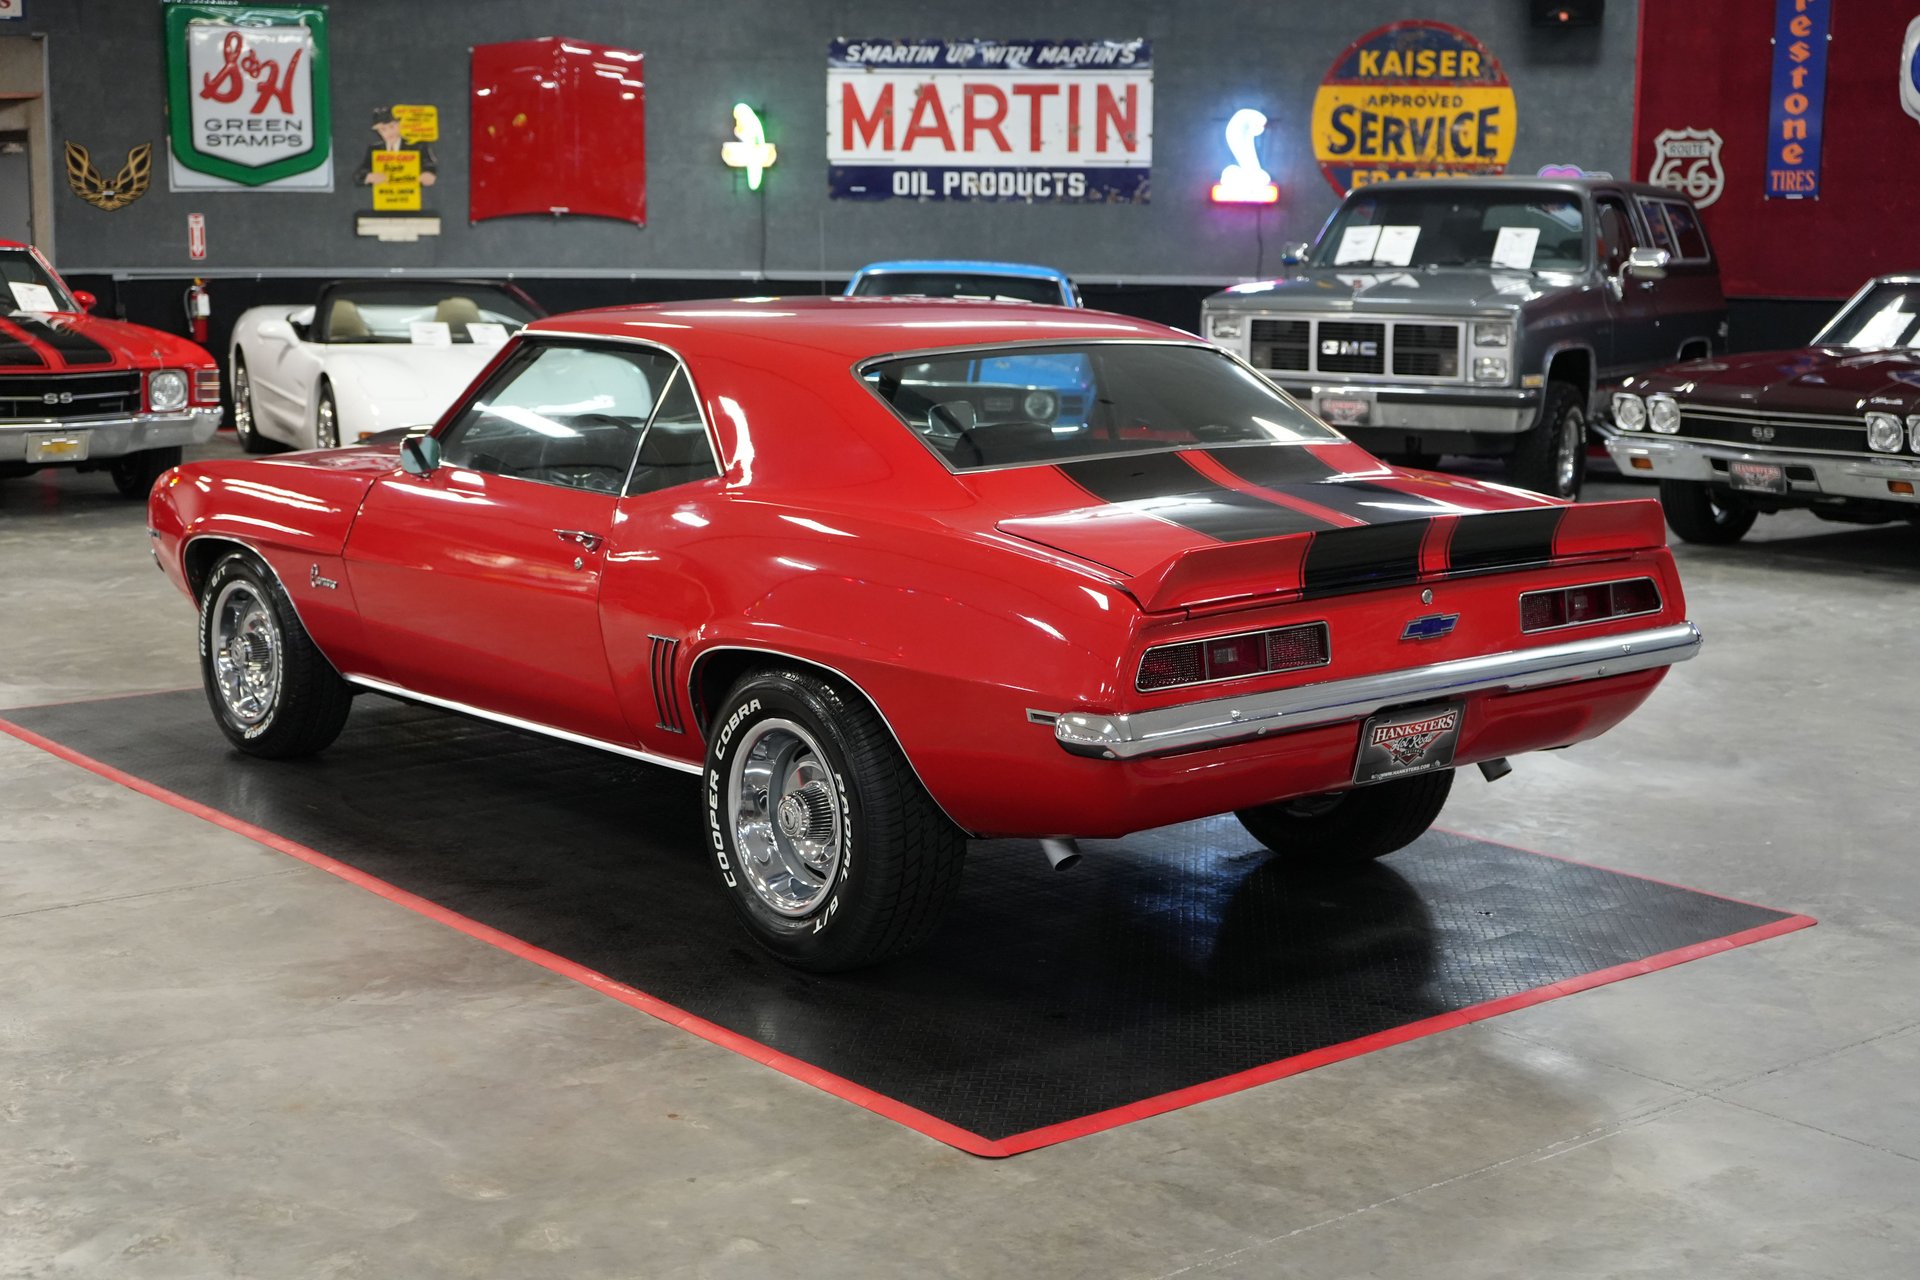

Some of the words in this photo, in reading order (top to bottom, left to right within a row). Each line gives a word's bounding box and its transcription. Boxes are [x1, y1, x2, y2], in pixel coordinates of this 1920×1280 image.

[946, 46, 974, 64] UP
[982, 46, 1031, 63] WITH
[1358, 50, 1481, 77] KAISER
[1366, 95, 1464, 108] APPROVED
[204, 118, 303, 132] GREEN
[842, 82, 1138, 153] MARTIN
[1328, 104, 1500, 158] SERVICE
[206, 134, 303, 147] STAMPS
[1669, 144, 1705, 155] ROUTE
[892, 171, 936, 196] OIL
[943, 172, 1086, 197] PRODUCTS
[1660, 158, 1711, 198] 66
[1770, 170, 1816, 192] TIRES
[1321, 340, 1378, 356] GMC
[715, 698, 762, 761] COBRA
[1374, 714, 1455, 743] HANKSTERS
[708, 768, 738, 889] COOPER
[835, 773, 853, 884] RADIAL
[812, 895, 840, 935] G/T
